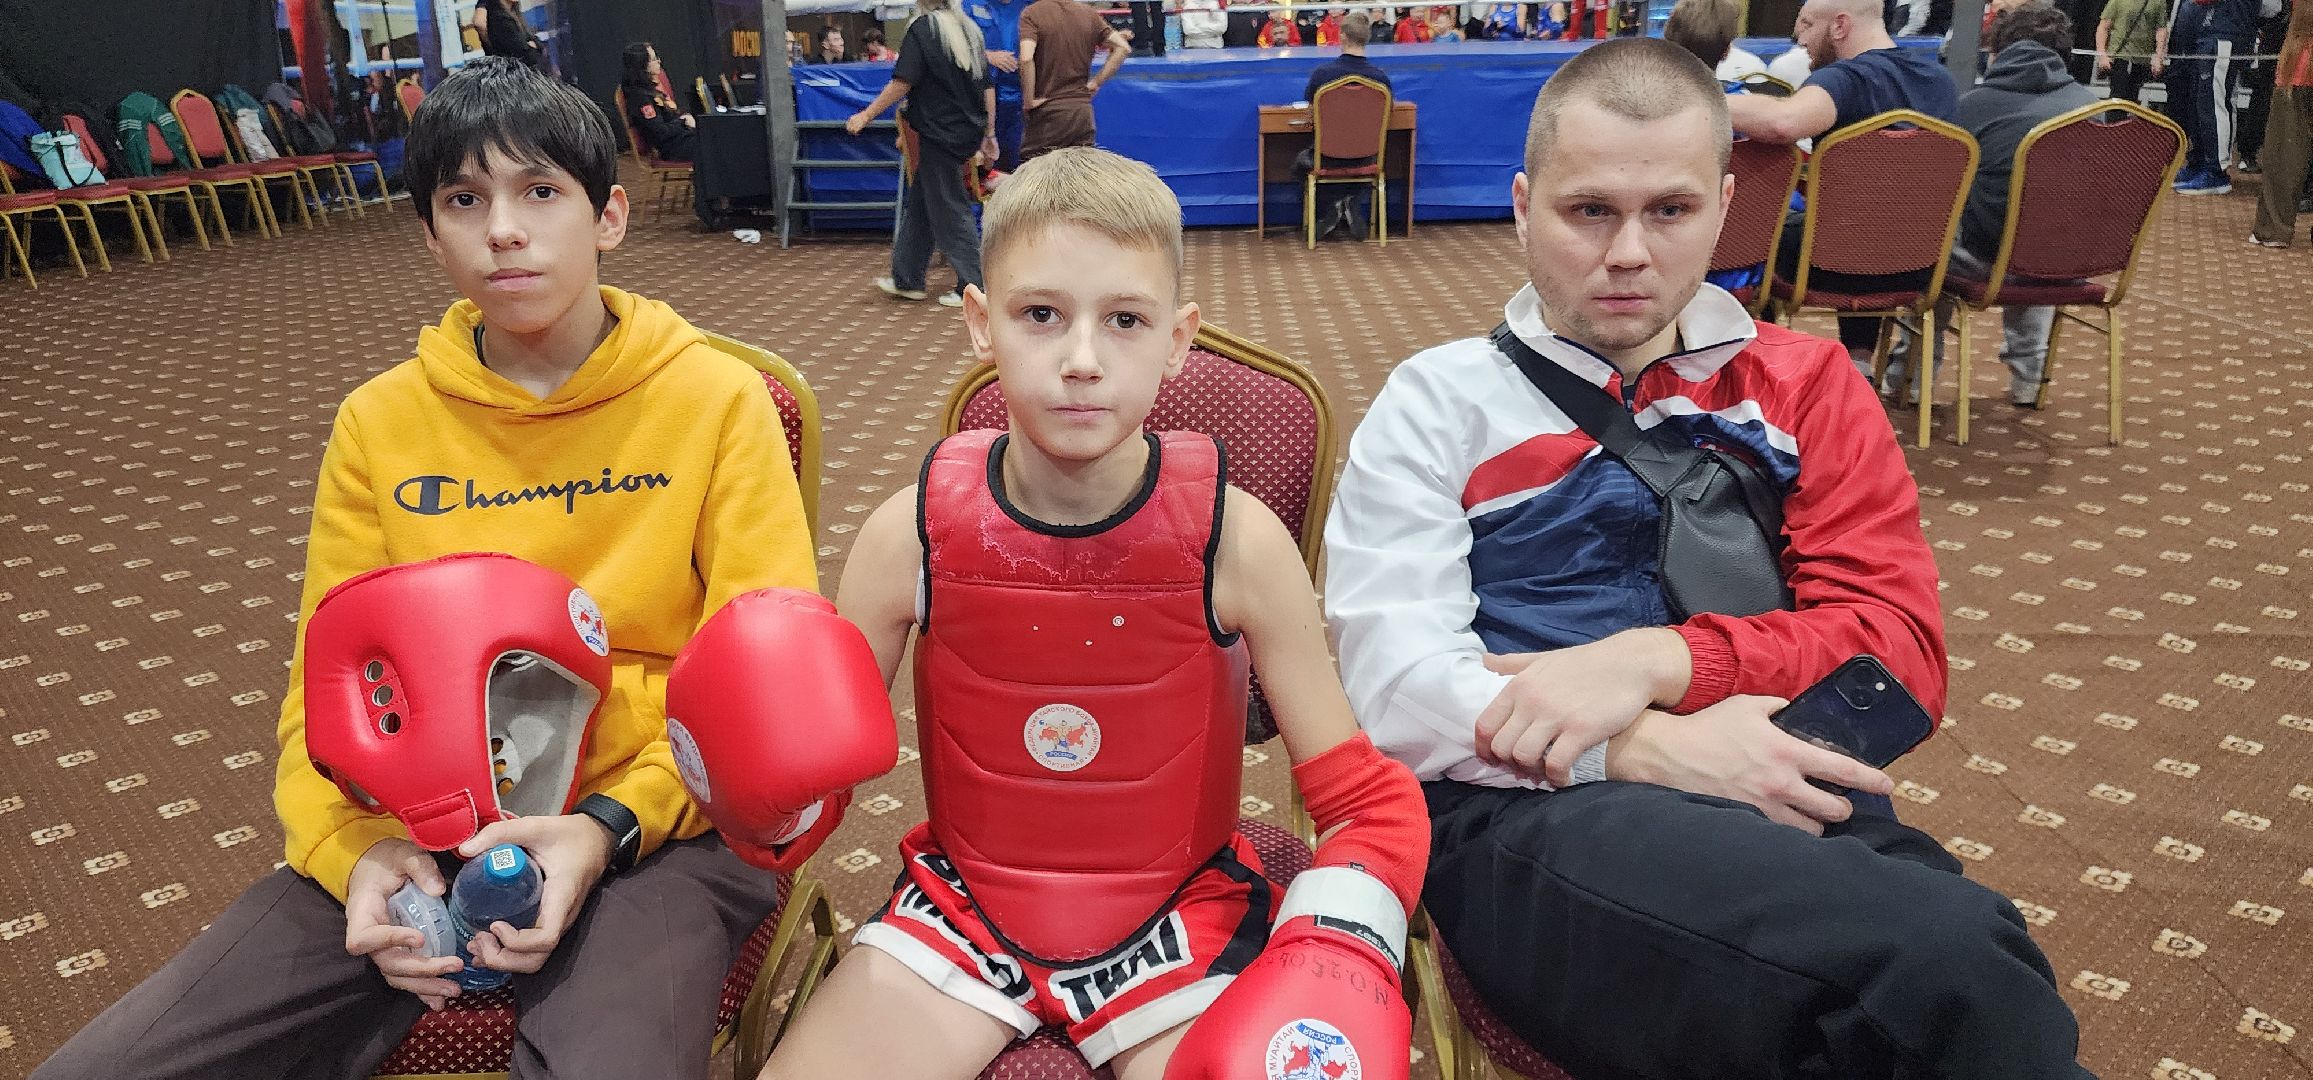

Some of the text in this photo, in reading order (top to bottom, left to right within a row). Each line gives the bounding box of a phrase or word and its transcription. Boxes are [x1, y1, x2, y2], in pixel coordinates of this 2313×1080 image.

[393, 468, 673, 515] Champion
[1268, 1026, 1296, 1071] МУАЙТАЙ
[1302, 1026, 1337, 1045] РОССИЯ
